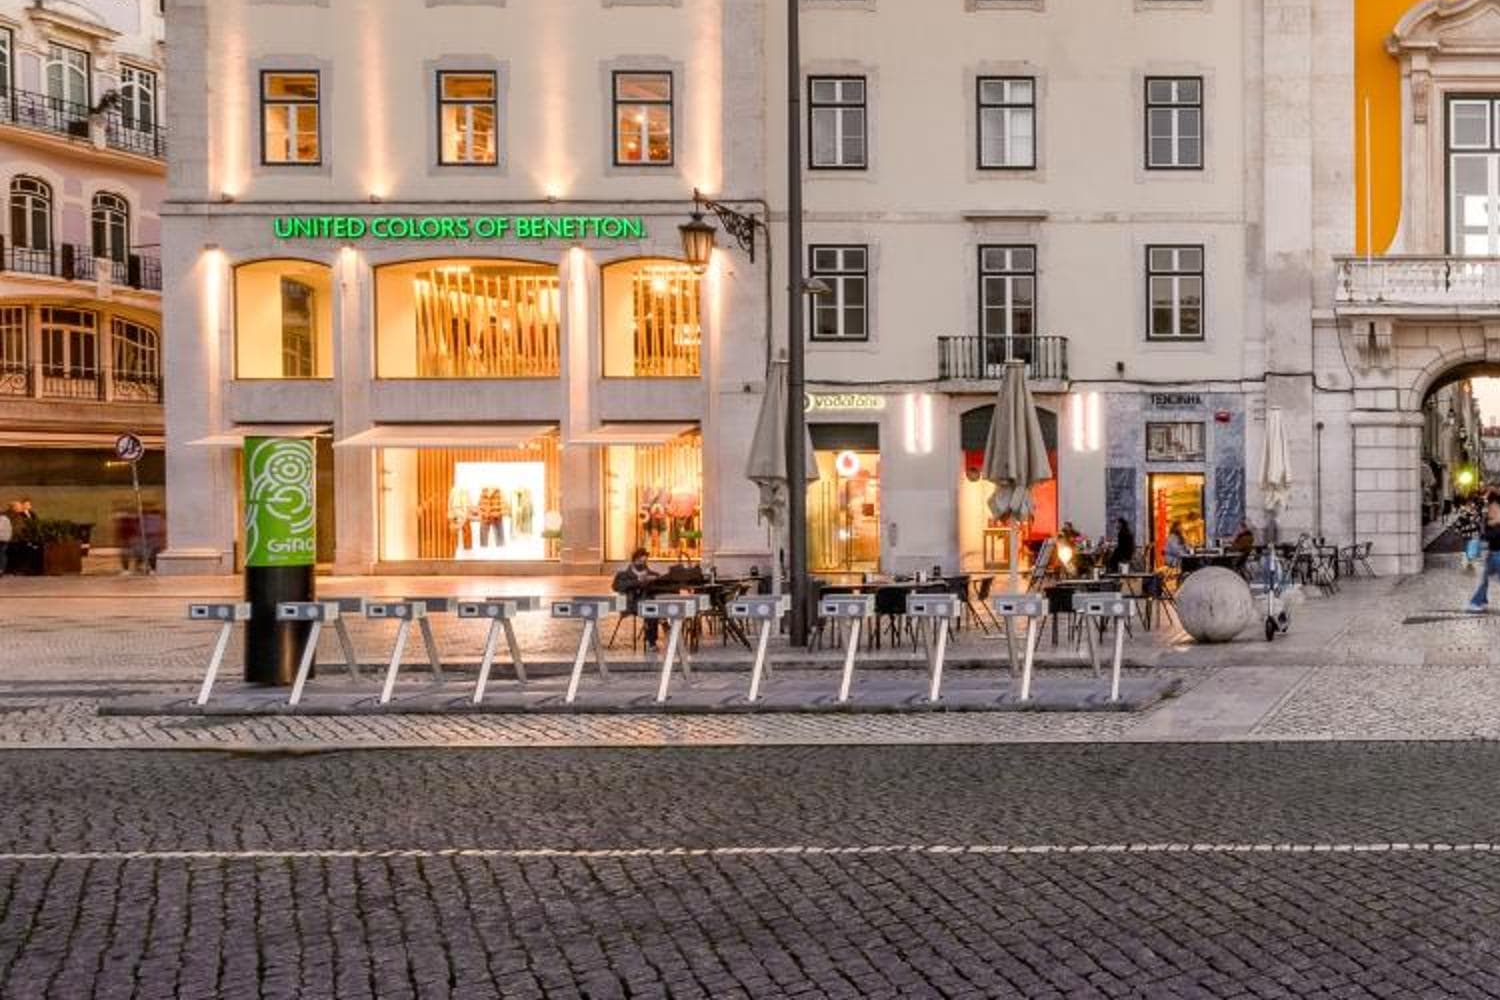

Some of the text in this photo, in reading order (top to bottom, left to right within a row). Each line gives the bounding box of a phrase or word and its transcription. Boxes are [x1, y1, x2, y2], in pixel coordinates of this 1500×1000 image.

[275, 216, 365, 240] UNITED
[371, 216, 469, 240] COLORS
[475, 216, 509, 239] OF
